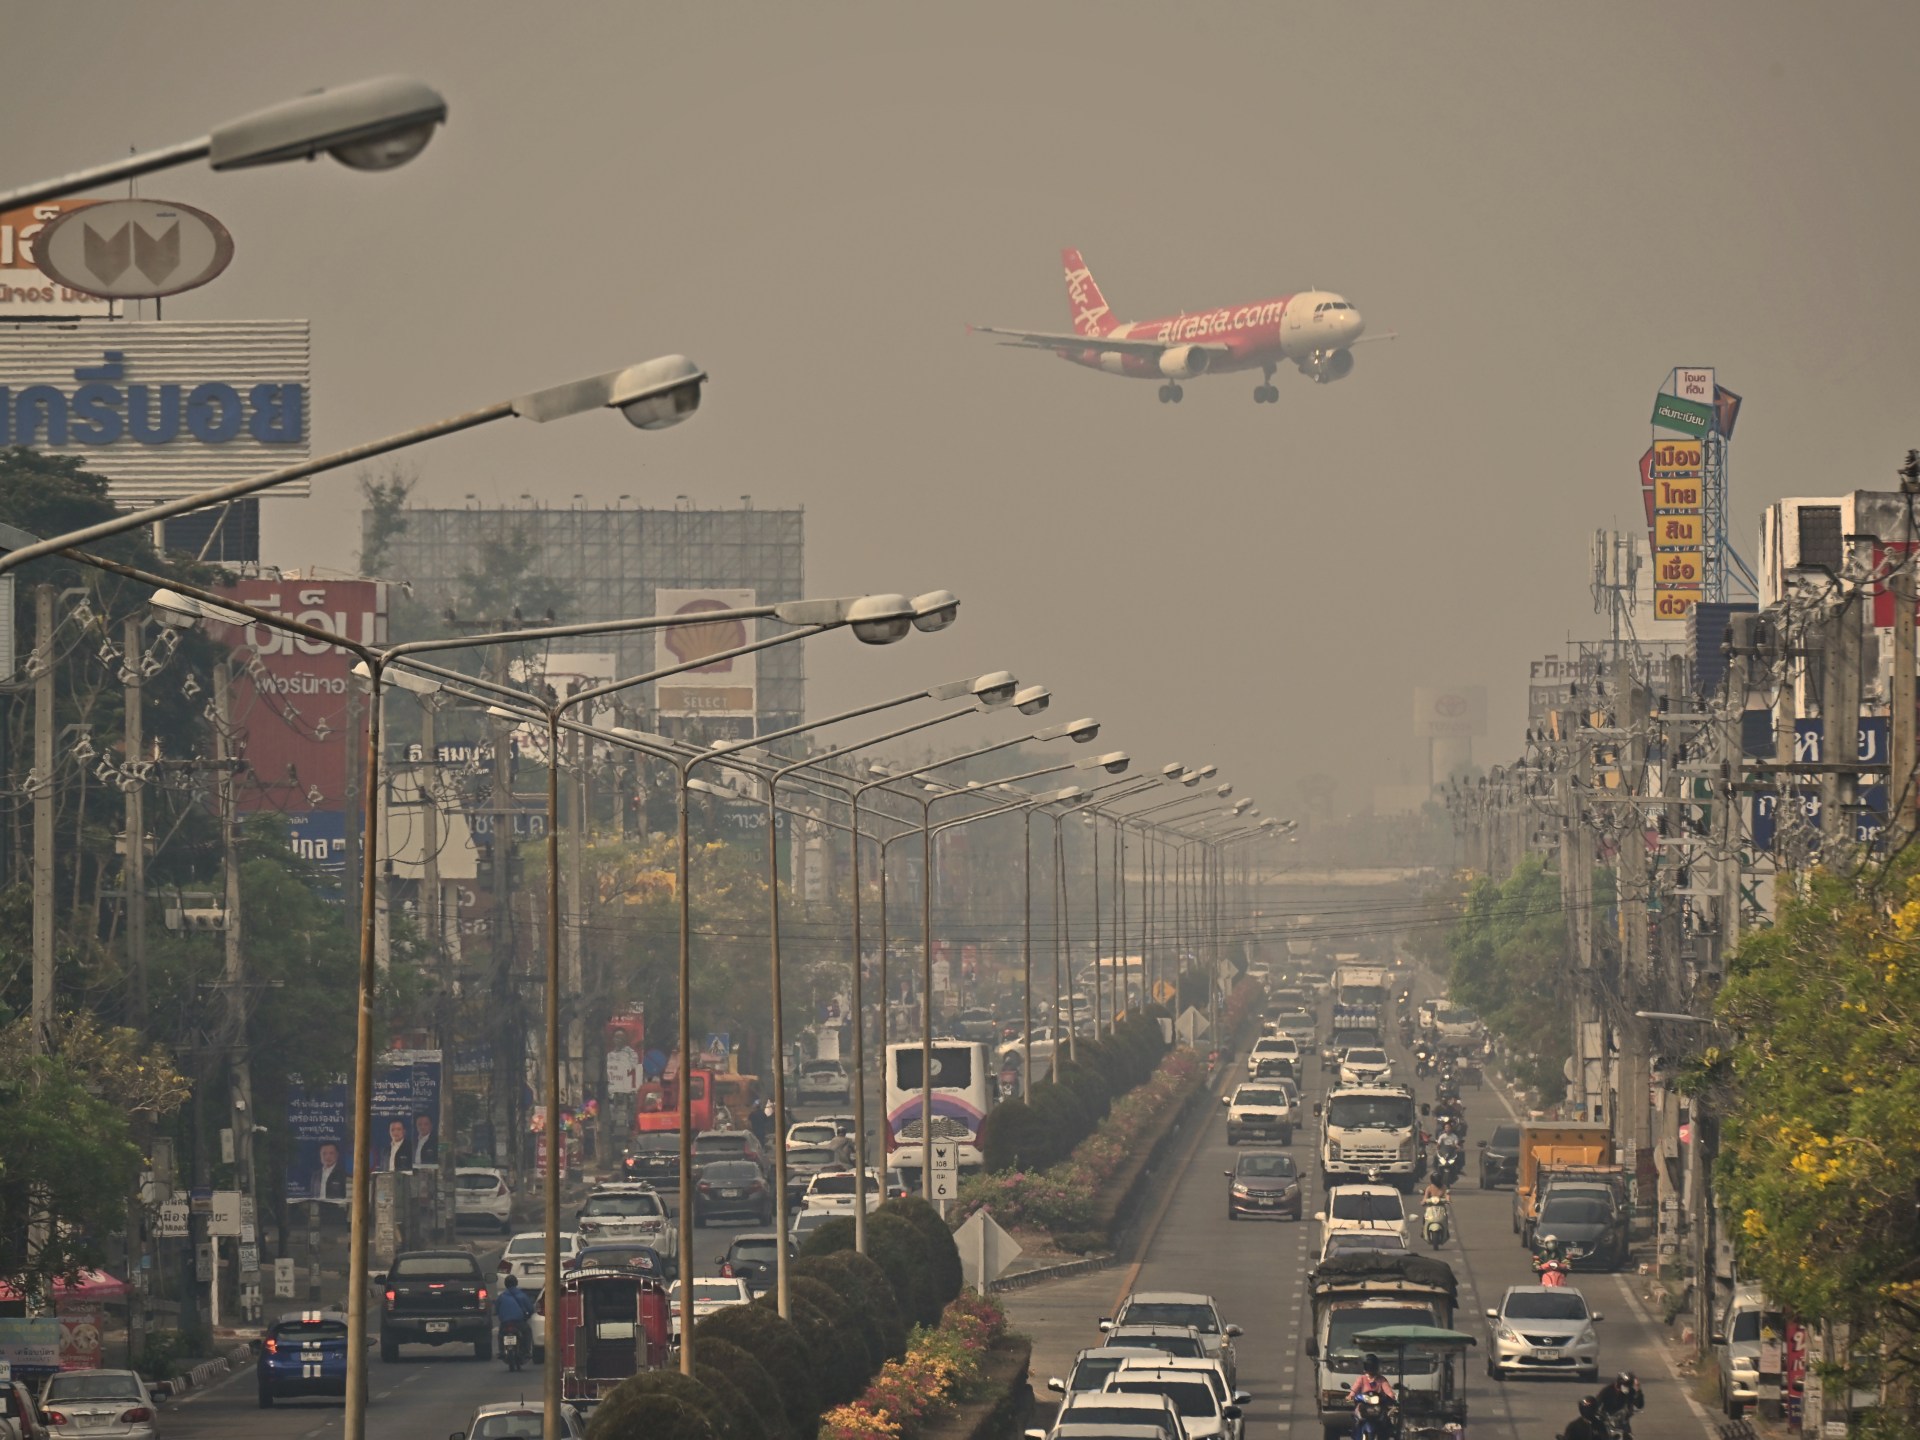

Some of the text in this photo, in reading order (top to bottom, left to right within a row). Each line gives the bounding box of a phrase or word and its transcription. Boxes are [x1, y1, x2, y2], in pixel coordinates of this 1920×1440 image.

[1157, 301, 1283, 343] airasia.com
[1658, 405, 1705, 426] เล่มทะเบียน
[1655, 445, 1700, 467] เมือง
[1661, 481, 1697, 505] ไทย
[1665, 520, 1693, 540] สิน
[1662, 555, 1695, 580] เชื่อ
[683, 696, 728, 708] SELECT
[936, 1160, 947, 1168] 108
[937, 1184, 947, 1195] 6
